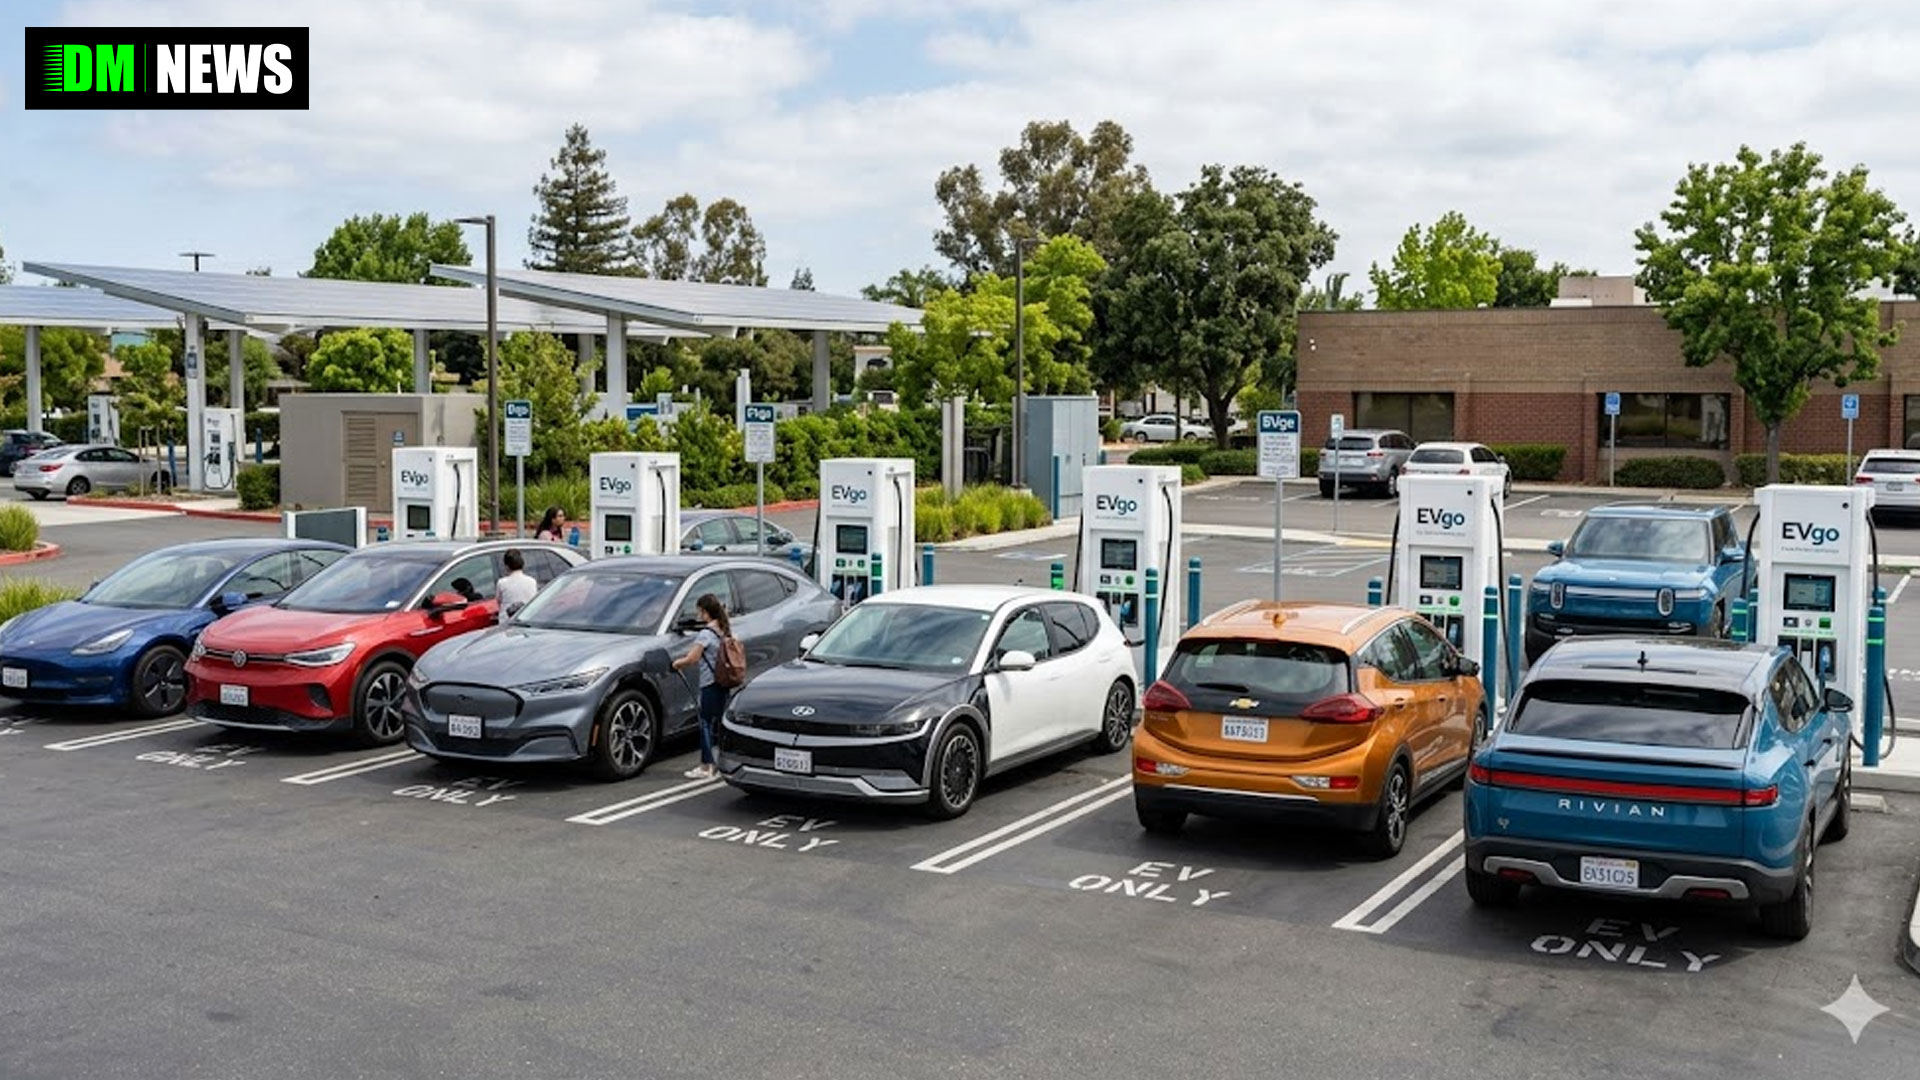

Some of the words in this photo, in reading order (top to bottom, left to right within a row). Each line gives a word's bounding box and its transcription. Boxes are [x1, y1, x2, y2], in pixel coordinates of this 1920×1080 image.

[401, 470, 429, 486] EVgo
[600, 476, 632, 494] EVgo
[831, 484, 867, 503] EVgo
[1096, 494, 1137, 515] EVgo
[1417, 507, 1465, 529] EVgo
[1782, 522, 1840, 545] EVgo
[1558, 798, 1665, 817] RIVIAN
[756, 814, 838, 832] EV
[698, 826, 840, 852] ONLY
[1127, 861, 1216, 882] EV
[1068, 874, 1232, 906] ONLY
[1585, 918, 1680, 942] EV
[1530, 934, 1722, 972] ONLY
